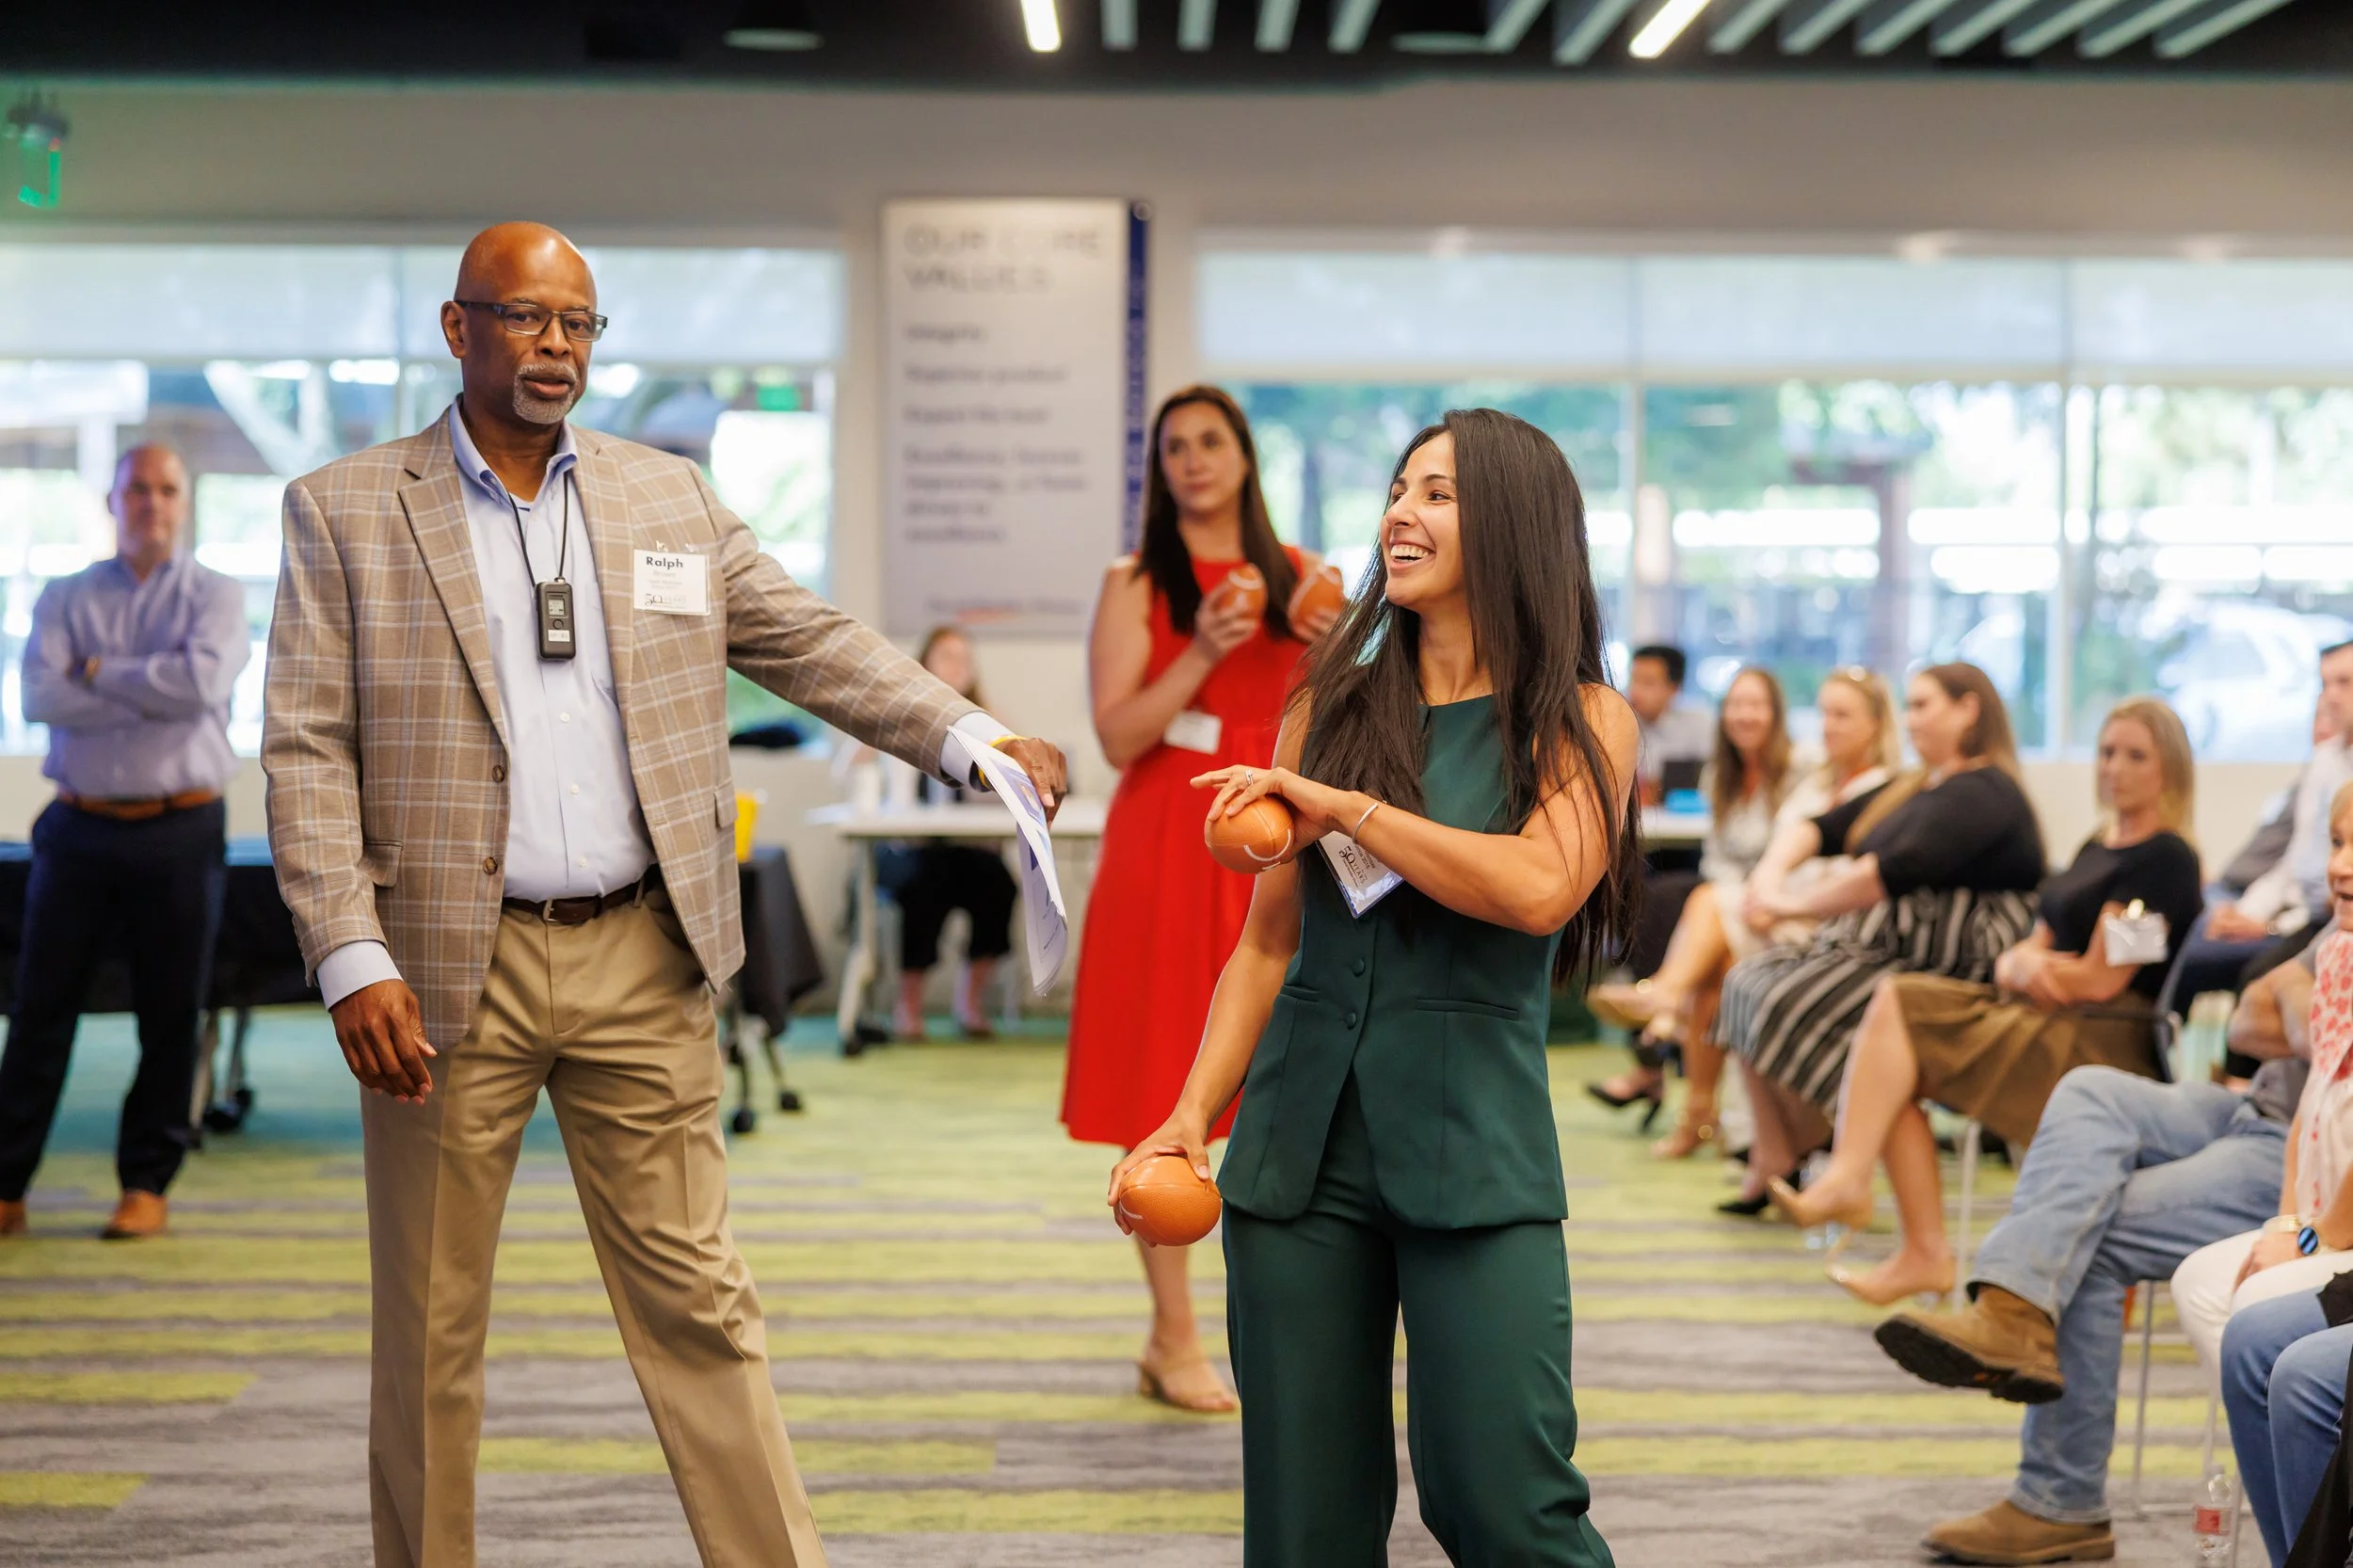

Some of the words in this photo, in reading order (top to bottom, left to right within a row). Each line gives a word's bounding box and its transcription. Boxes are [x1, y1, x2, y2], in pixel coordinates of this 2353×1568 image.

[905, 224, 988, 256] OUR
[646, 556, 683, 569] Ralph
[1338, 845, 1356, 864] 50
[1353, 863, 1366, 884] YEARS
